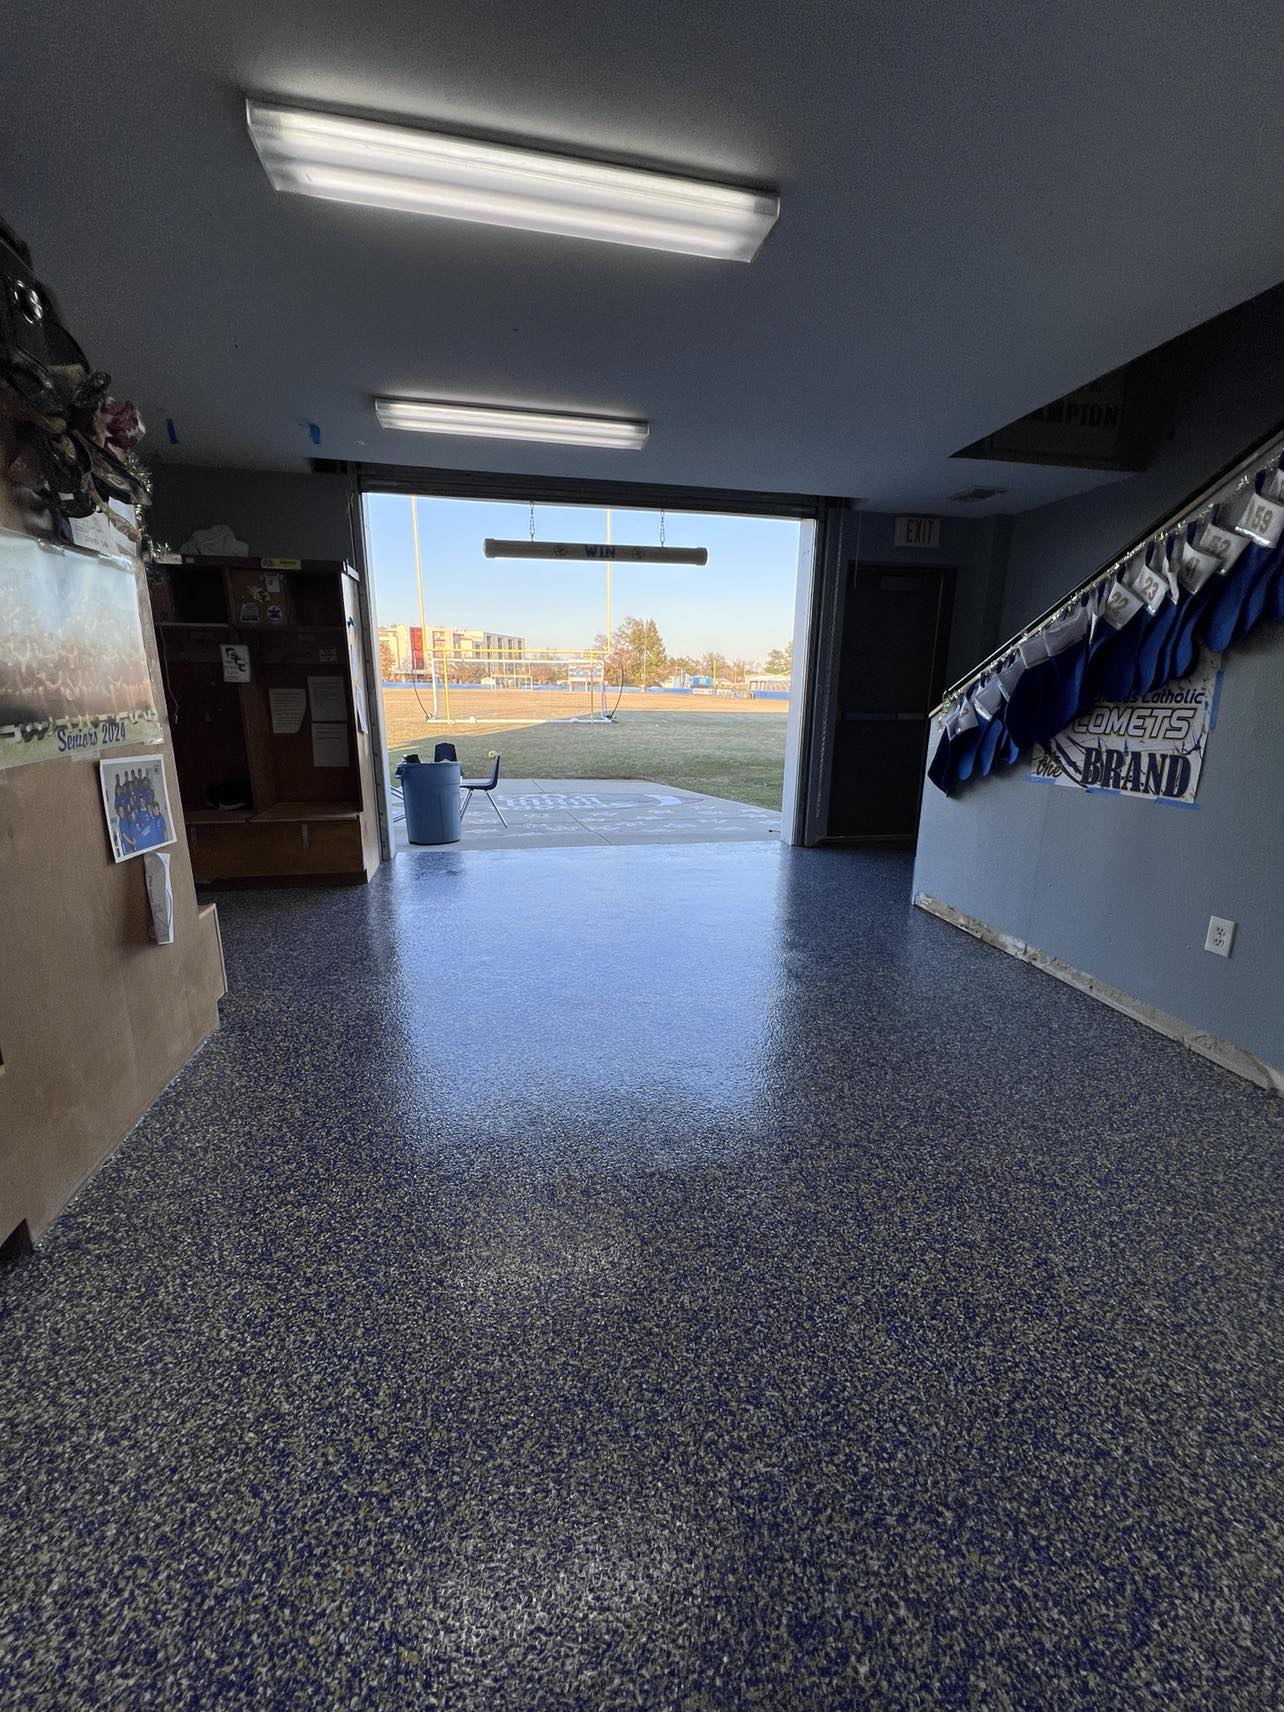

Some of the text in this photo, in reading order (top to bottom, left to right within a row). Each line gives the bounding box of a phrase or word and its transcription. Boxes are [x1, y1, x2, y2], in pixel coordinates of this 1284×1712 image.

[905, 519, 935, 544] EXIT
[584, 544, 616, 558] WIN
[1145, 576, 1159, 600] 23
[1142, 689, 1206, 705] Catholic
[1073, 706, 1197, 739] COMETS
[57, 722, 126, 753] Seniors 2024
[1035, 756, 1063, 778] the
[1081, 747, 1192, 798] BRAND
